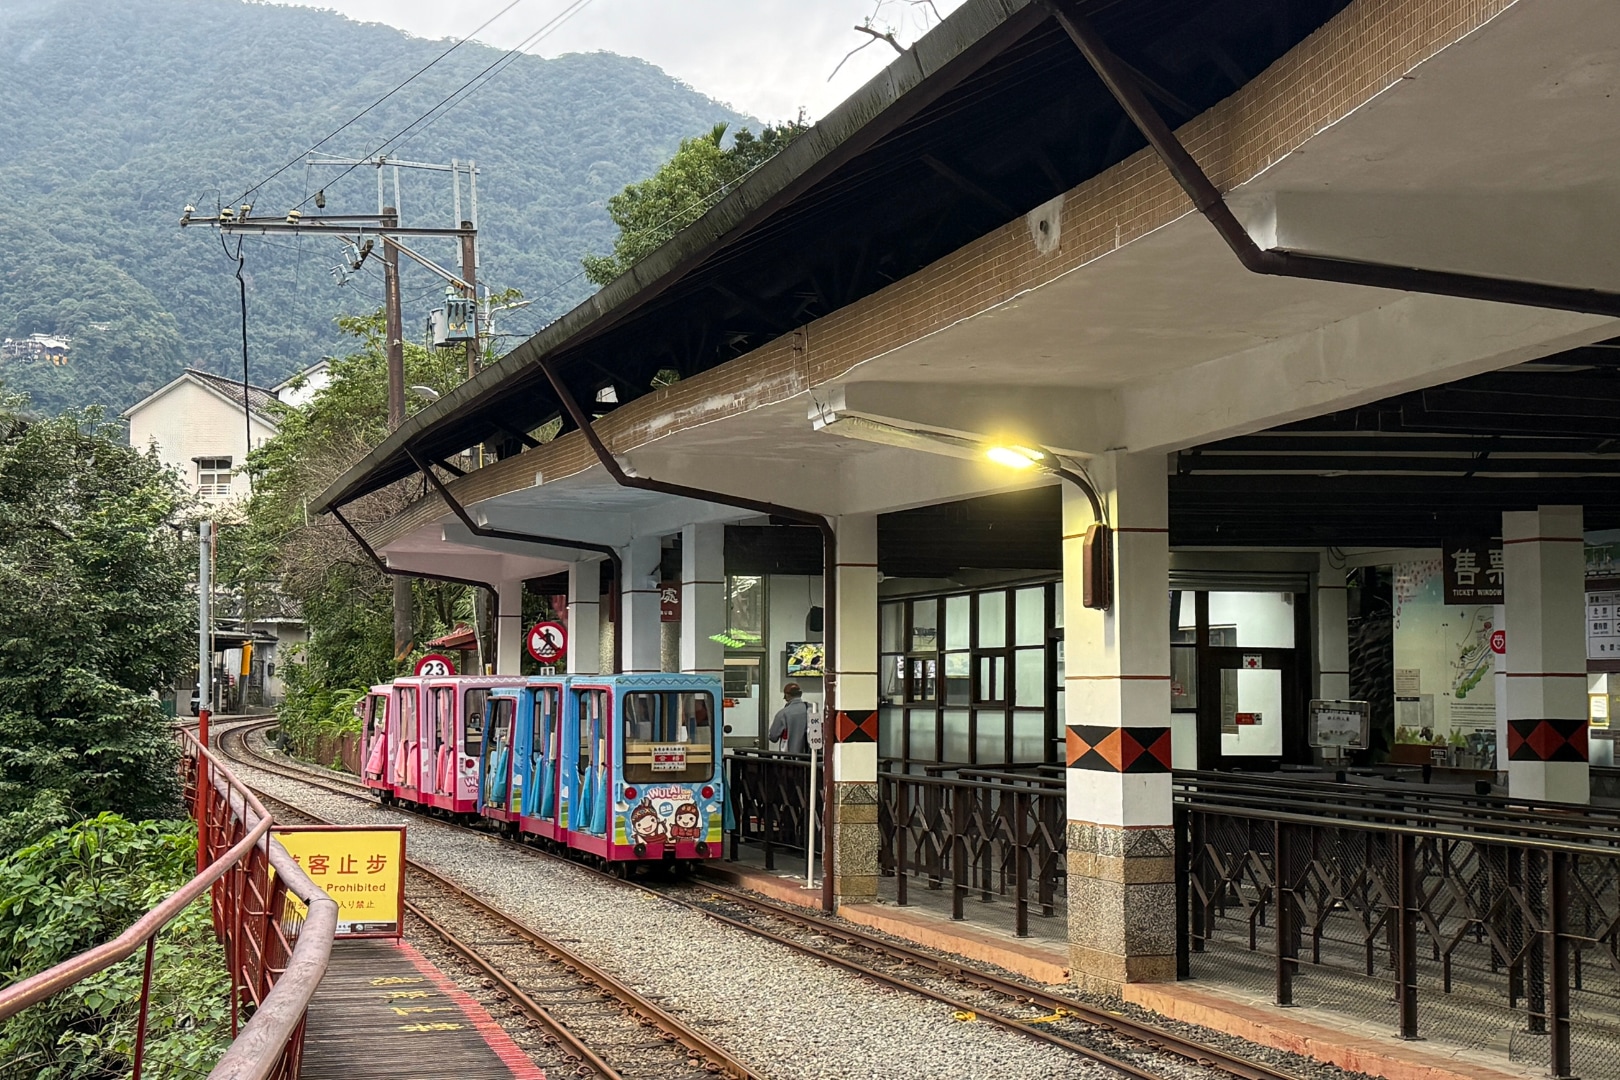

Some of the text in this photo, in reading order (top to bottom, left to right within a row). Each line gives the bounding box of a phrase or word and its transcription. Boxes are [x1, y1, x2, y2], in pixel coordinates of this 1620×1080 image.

[425, 663, 445, 676] 23
[648, 784, 682, 800] WULAI
[292, 854, 387, 875] 客止步
[326, 883, 386, 892] Prohibited
